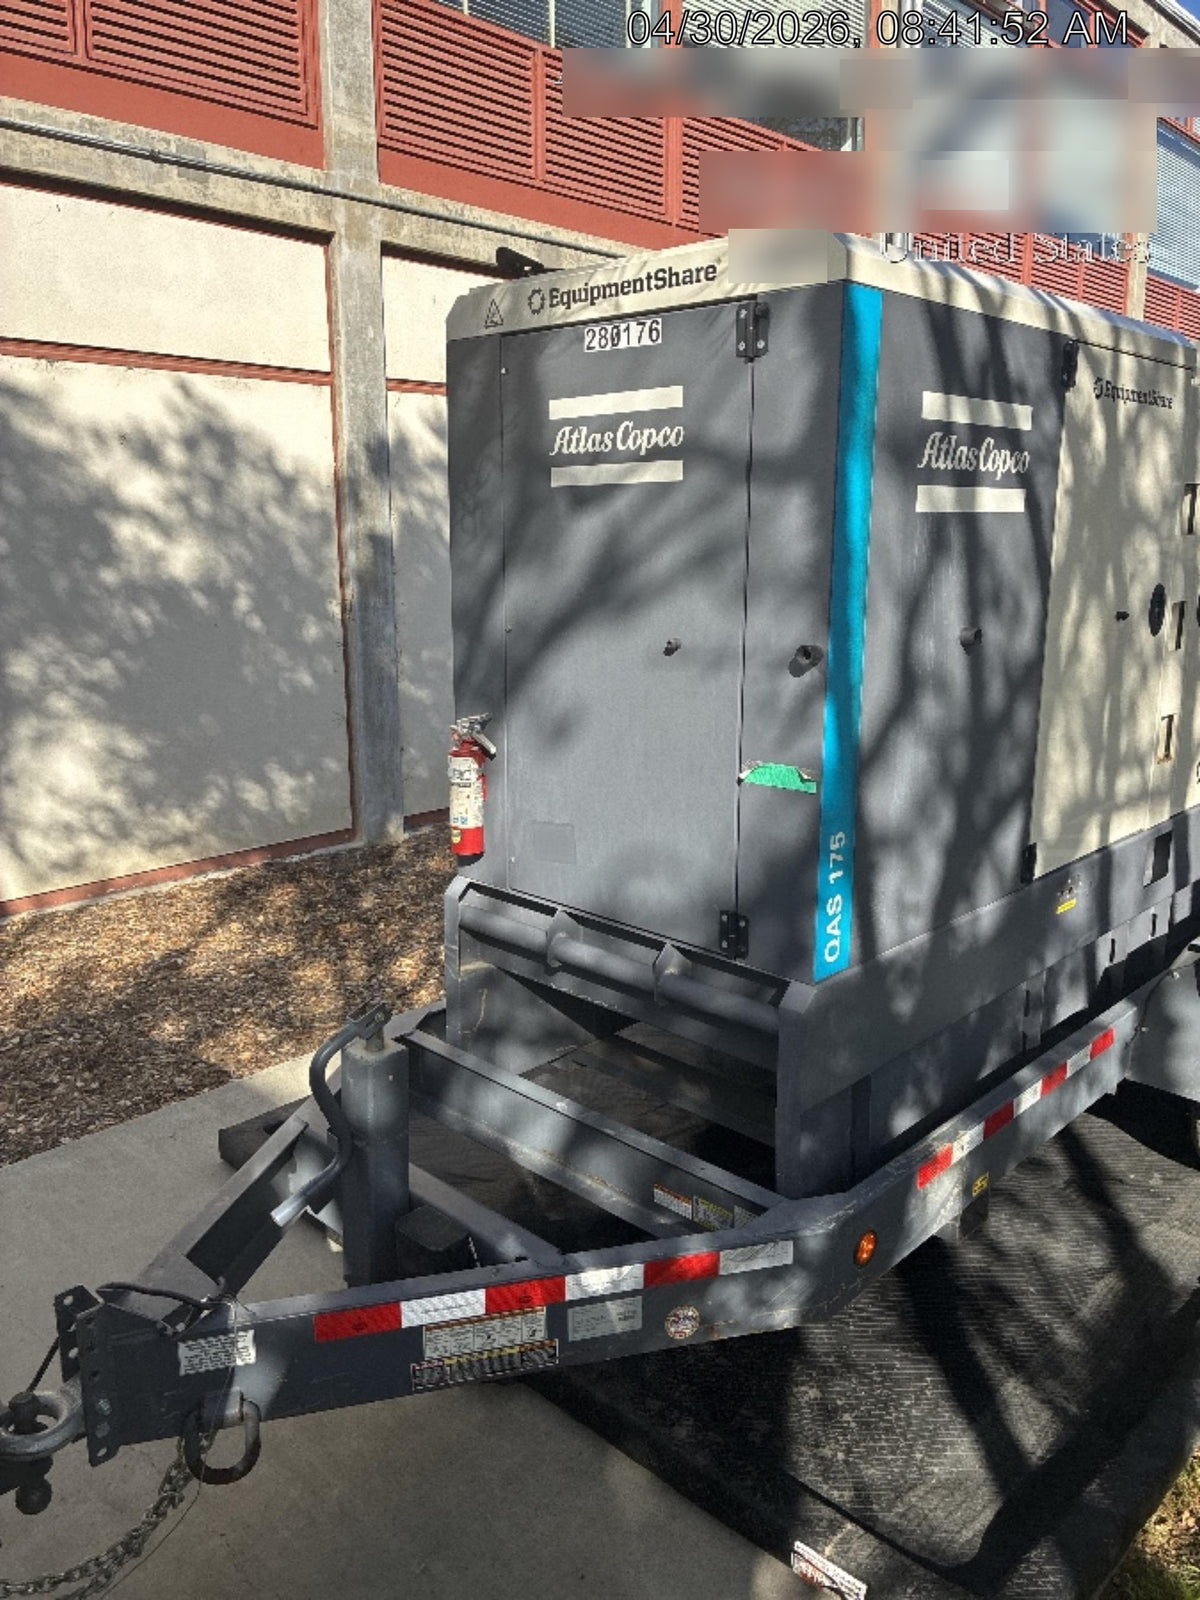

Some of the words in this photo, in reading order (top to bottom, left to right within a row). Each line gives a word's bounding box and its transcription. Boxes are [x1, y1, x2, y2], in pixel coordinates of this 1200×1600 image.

[549, 264, 718, 309] EquipmentShare
[586, 319, 661, 351] 280176
[549, 426, 614, 456] Atlas
[616, 420, 684, 456] Copco
[916, 431, 979, 472] Atlas
[979, 436, 1030, 481] Copco
[828, 831, 846, 884] 175
[824, 893, 842, 963] QAS
